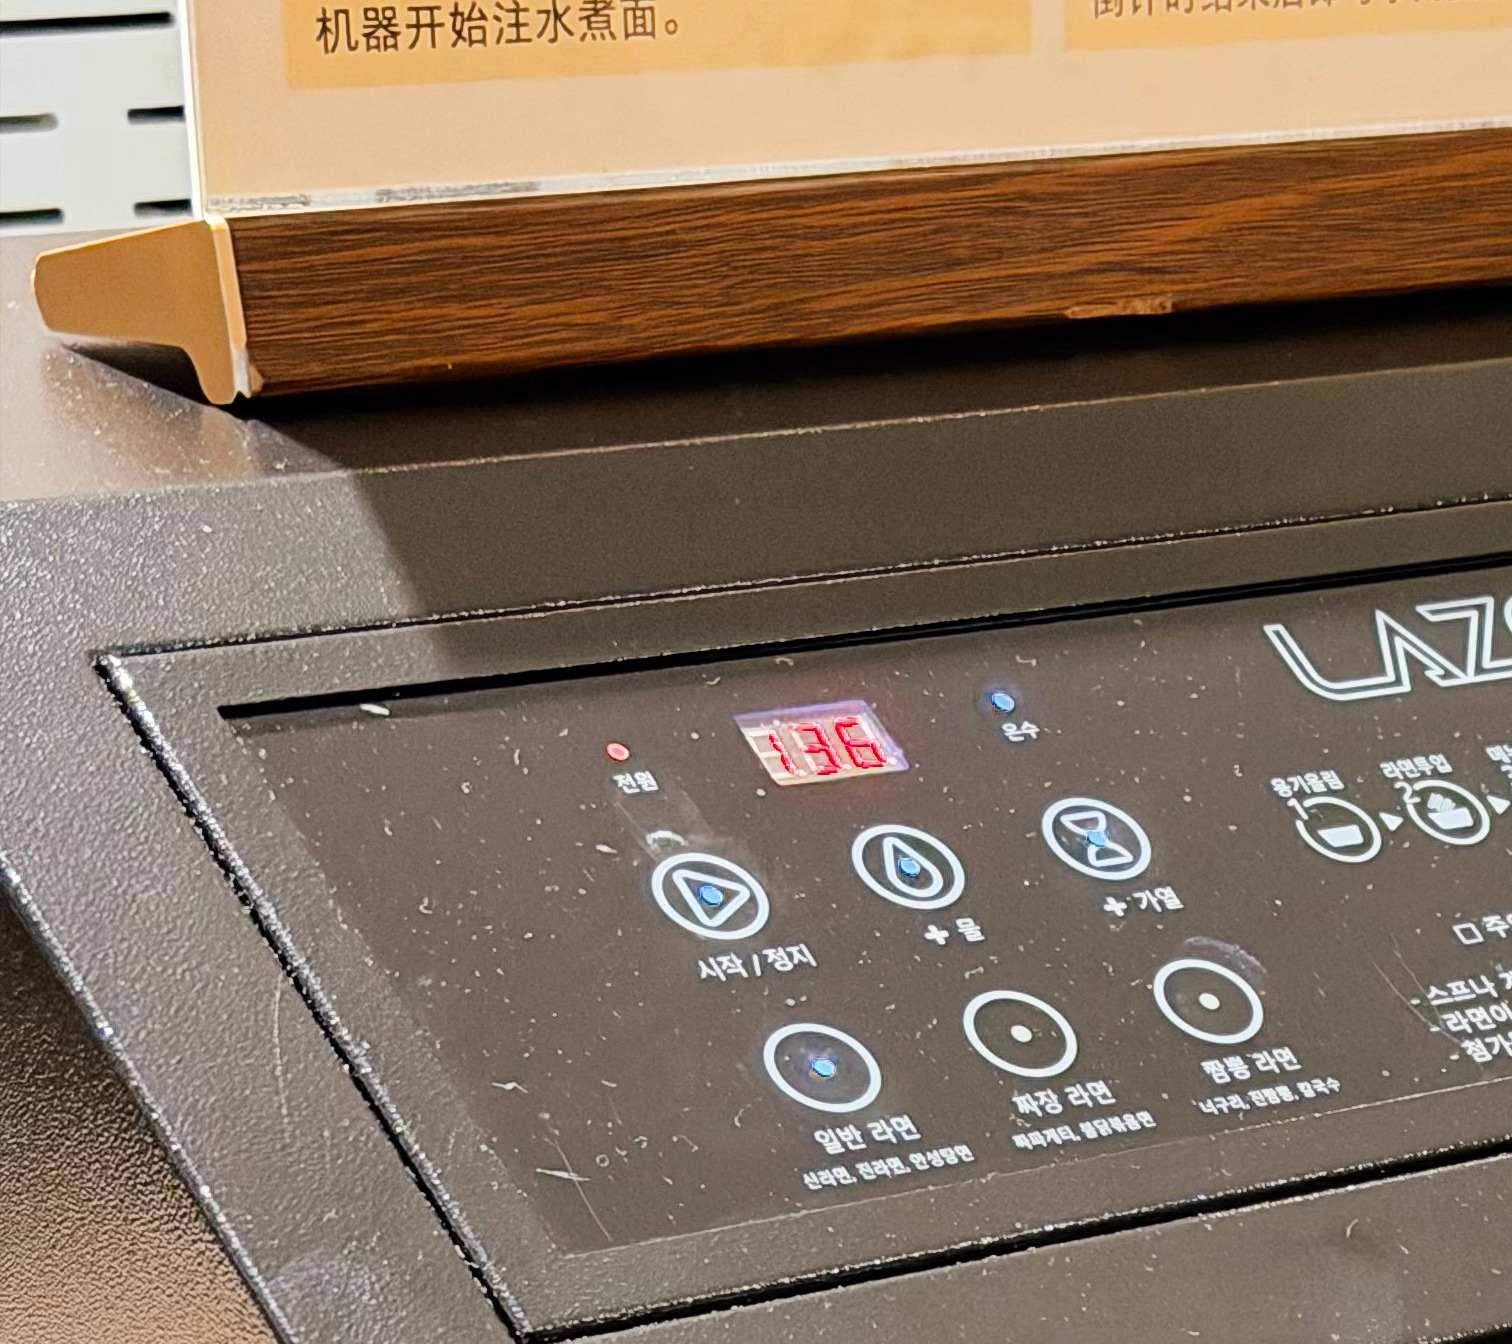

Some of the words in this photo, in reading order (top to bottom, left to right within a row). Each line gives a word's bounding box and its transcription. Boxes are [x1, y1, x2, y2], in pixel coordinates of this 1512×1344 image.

[315, 0, 680, 55] 机器开始注水煮面。
[768, 716, 888, 777] 136
[612, 770, 660, 795] 전원
[1380, 753, 1454, 779] 라면투입
[1132, 886, 1184, 914] 가열
[956, 917, 986, 944] 물
[699, 953, 748, 981] 시작
[765, 944, 817, 974] 정지
[1427, 975, 1498, 1006] 스프나
[1200, 1056, 1251, 1084] 짬뽕
[1251, 1046, 1302, 1074] 라면
[1012, 1088, 1062, 1119] 짜장
[1063, 1078, 1118, 1108] 라면
[814, 1126, 866, 1156] 일반
[867, 1114, 922, 1146] 라면
